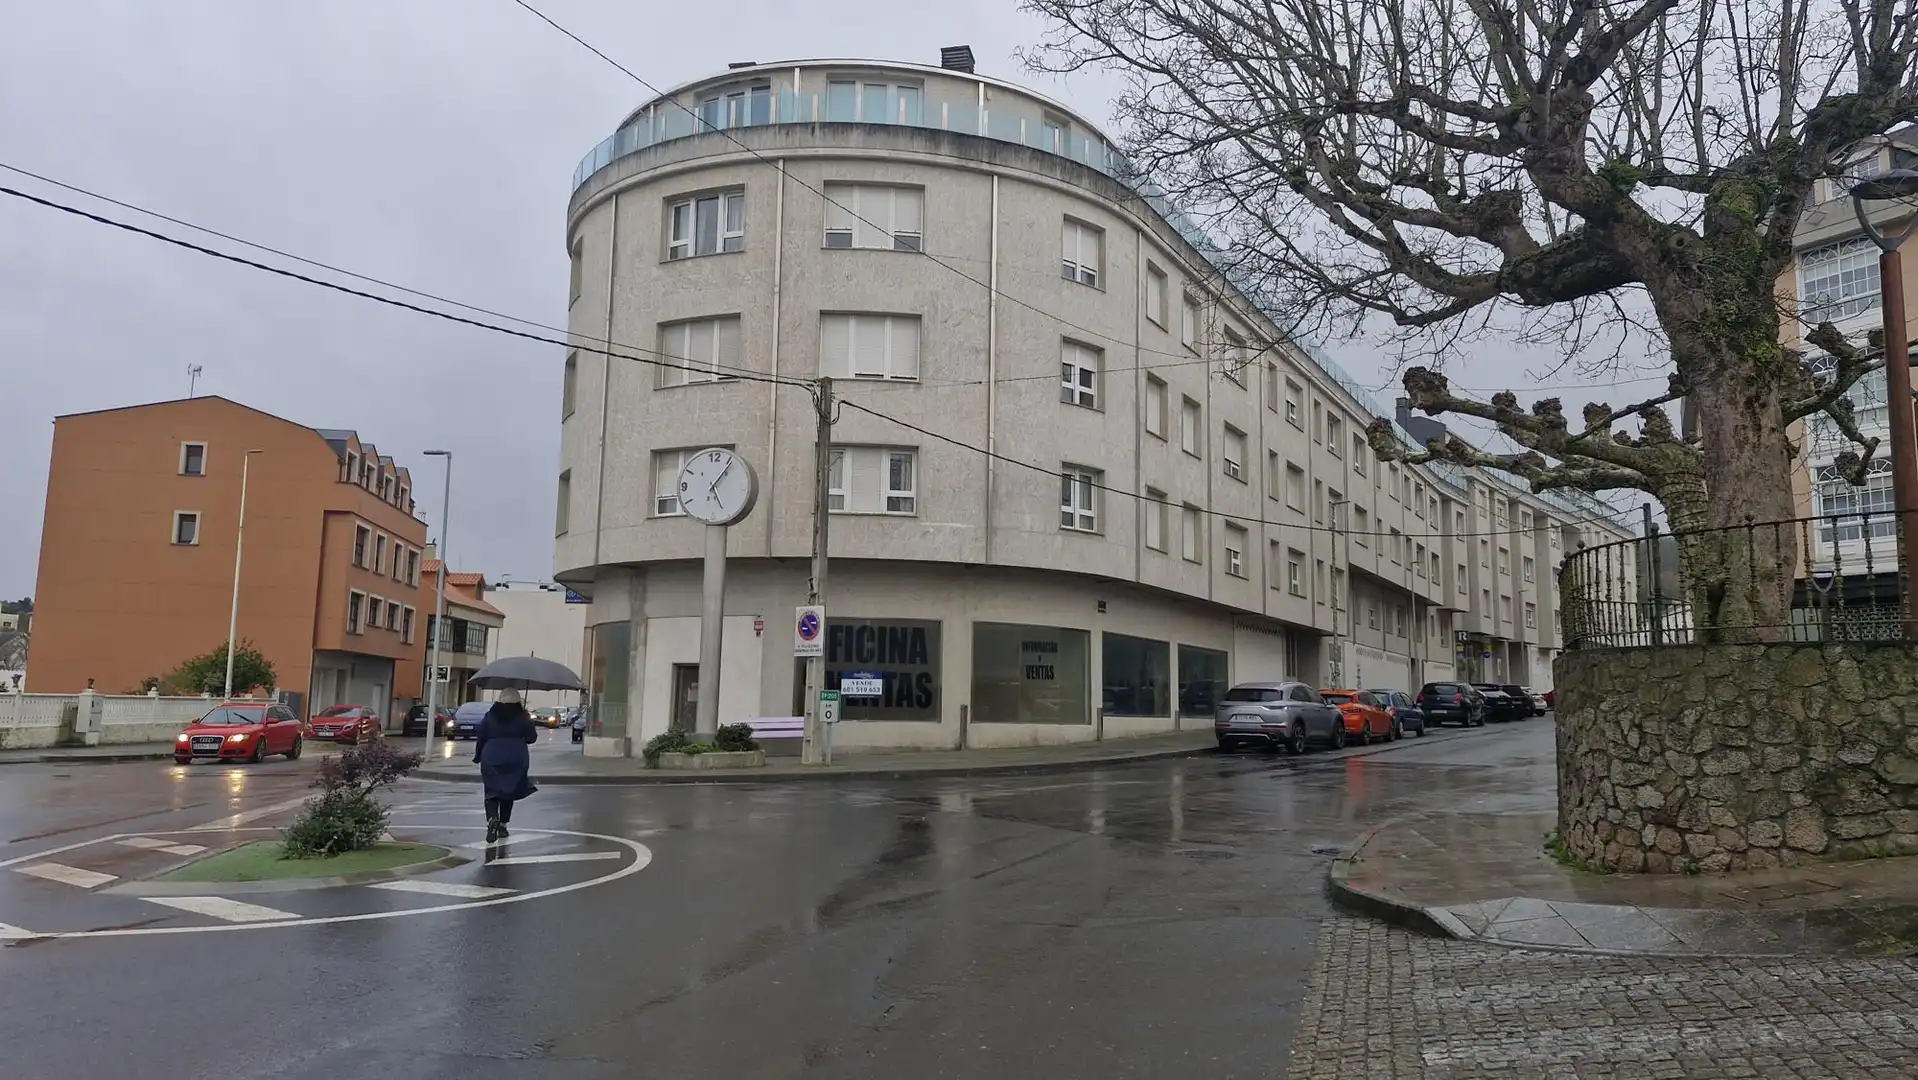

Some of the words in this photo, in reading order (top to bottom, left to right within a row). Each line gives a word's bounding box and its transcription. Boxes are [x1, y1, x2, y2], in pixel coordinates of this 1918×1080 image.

[708, 453, 721, 462] 12
[681, 482, 688, 491] 9
[827, 625, 928, 664] FICINA
[1025, 664, 1054, 680] VENTAS
